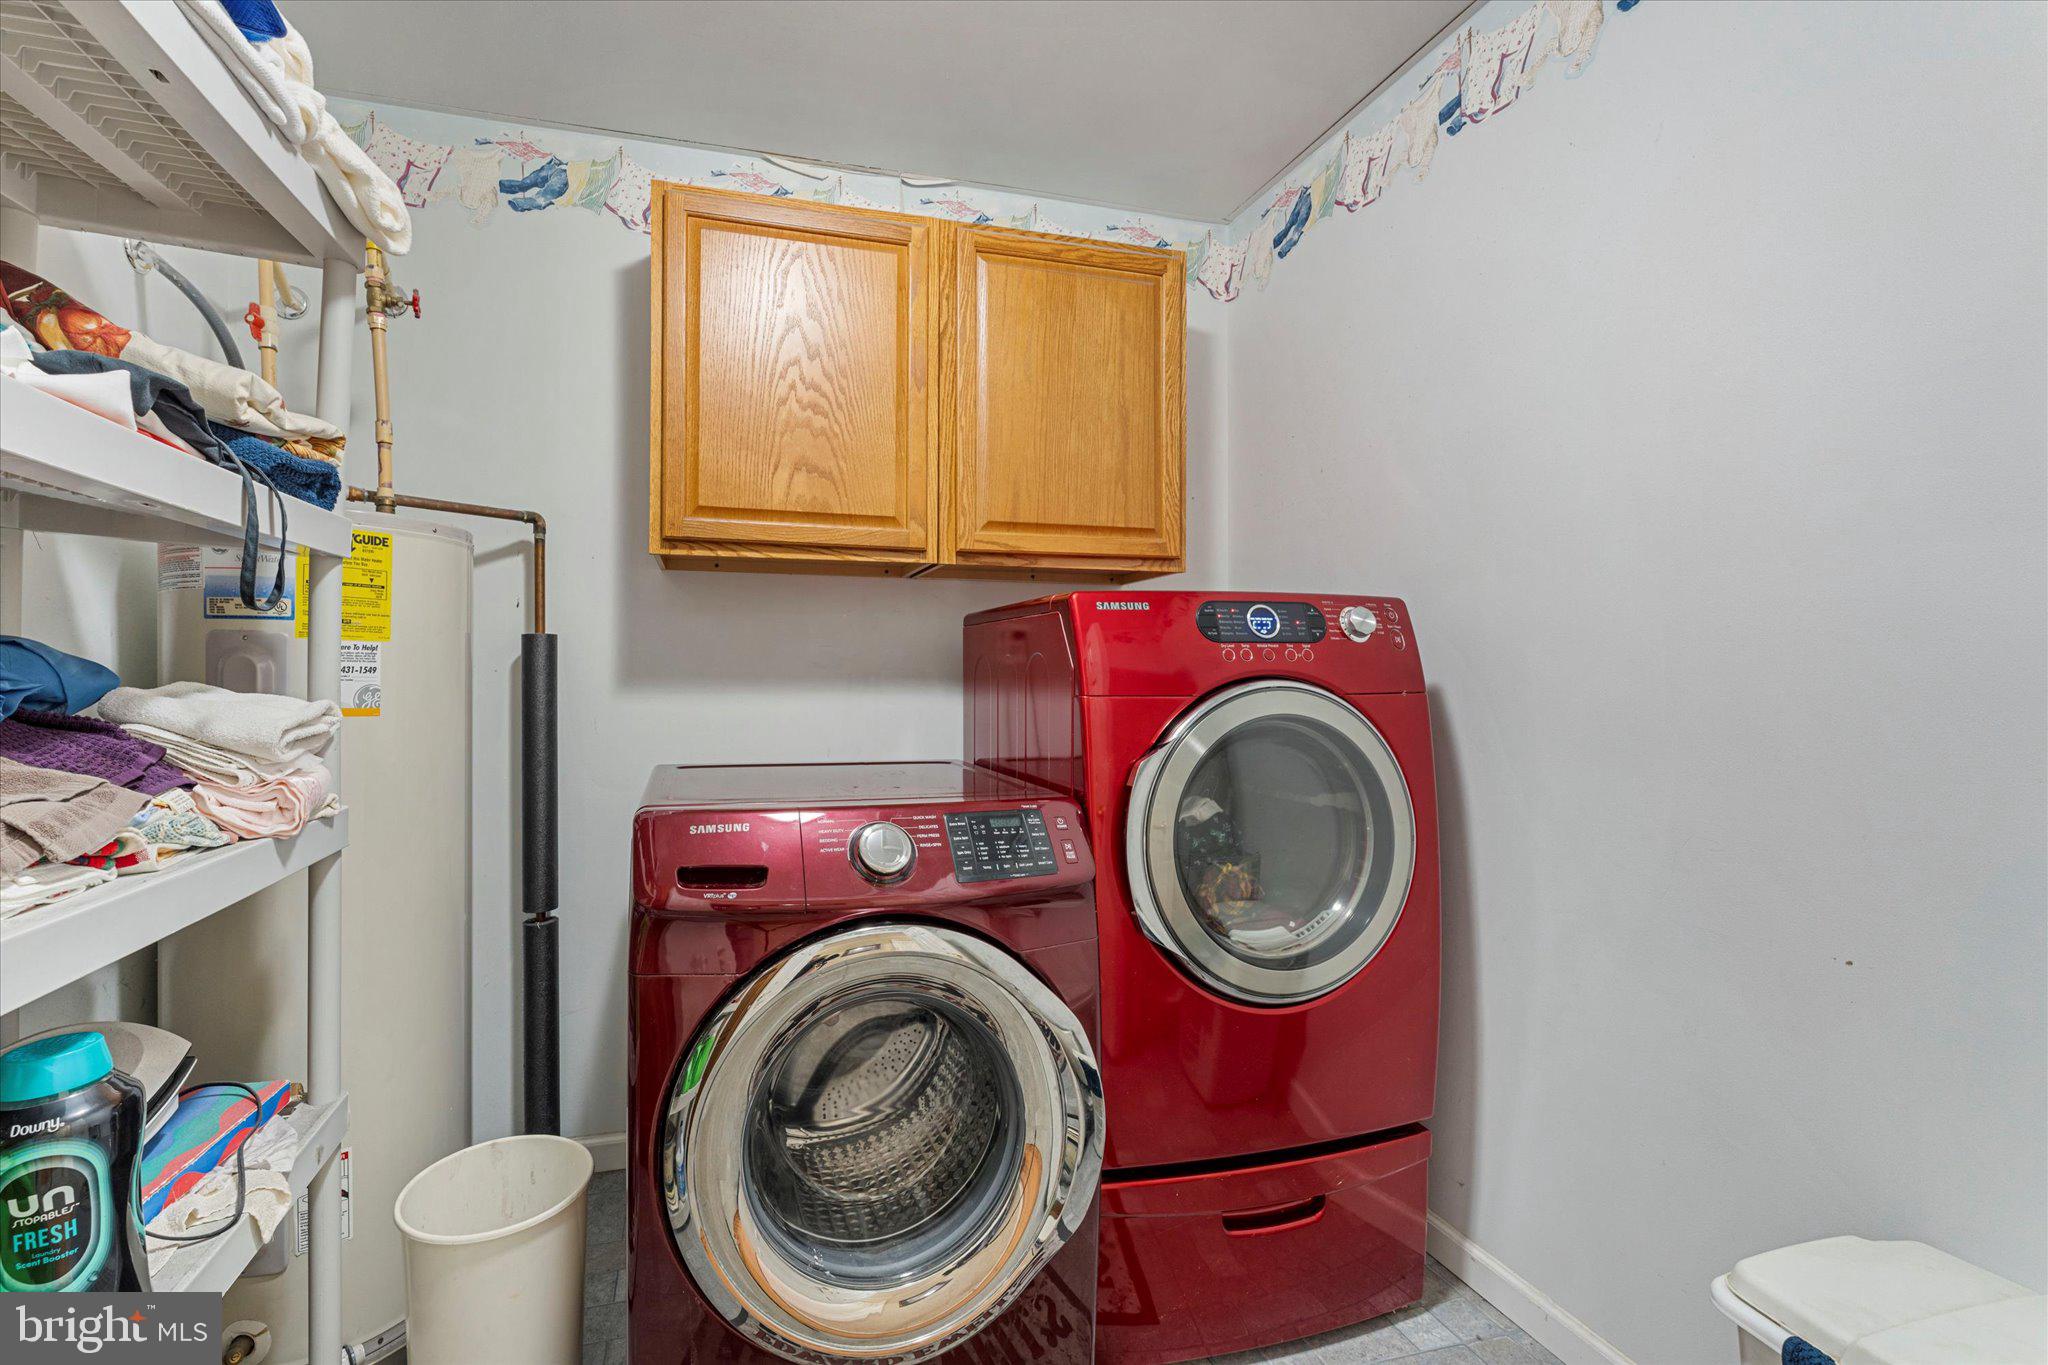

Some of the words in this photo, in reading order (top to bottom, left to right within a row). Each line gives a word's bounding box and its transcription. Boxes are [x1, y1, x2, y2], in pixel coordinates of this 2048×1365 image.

[1096, 601, 1150, 611] SAMSUNG
[340, 665, 377, 674] 431-1549
[689, 823, 750, 834] SAMSUNG
[12, 1218, 79, 1253] FRESH
[15, 1258, 42, 1271] Scent
[43, 1246, 79, 1265] Booster
[31, 1246, 61, 1259] Laundry
